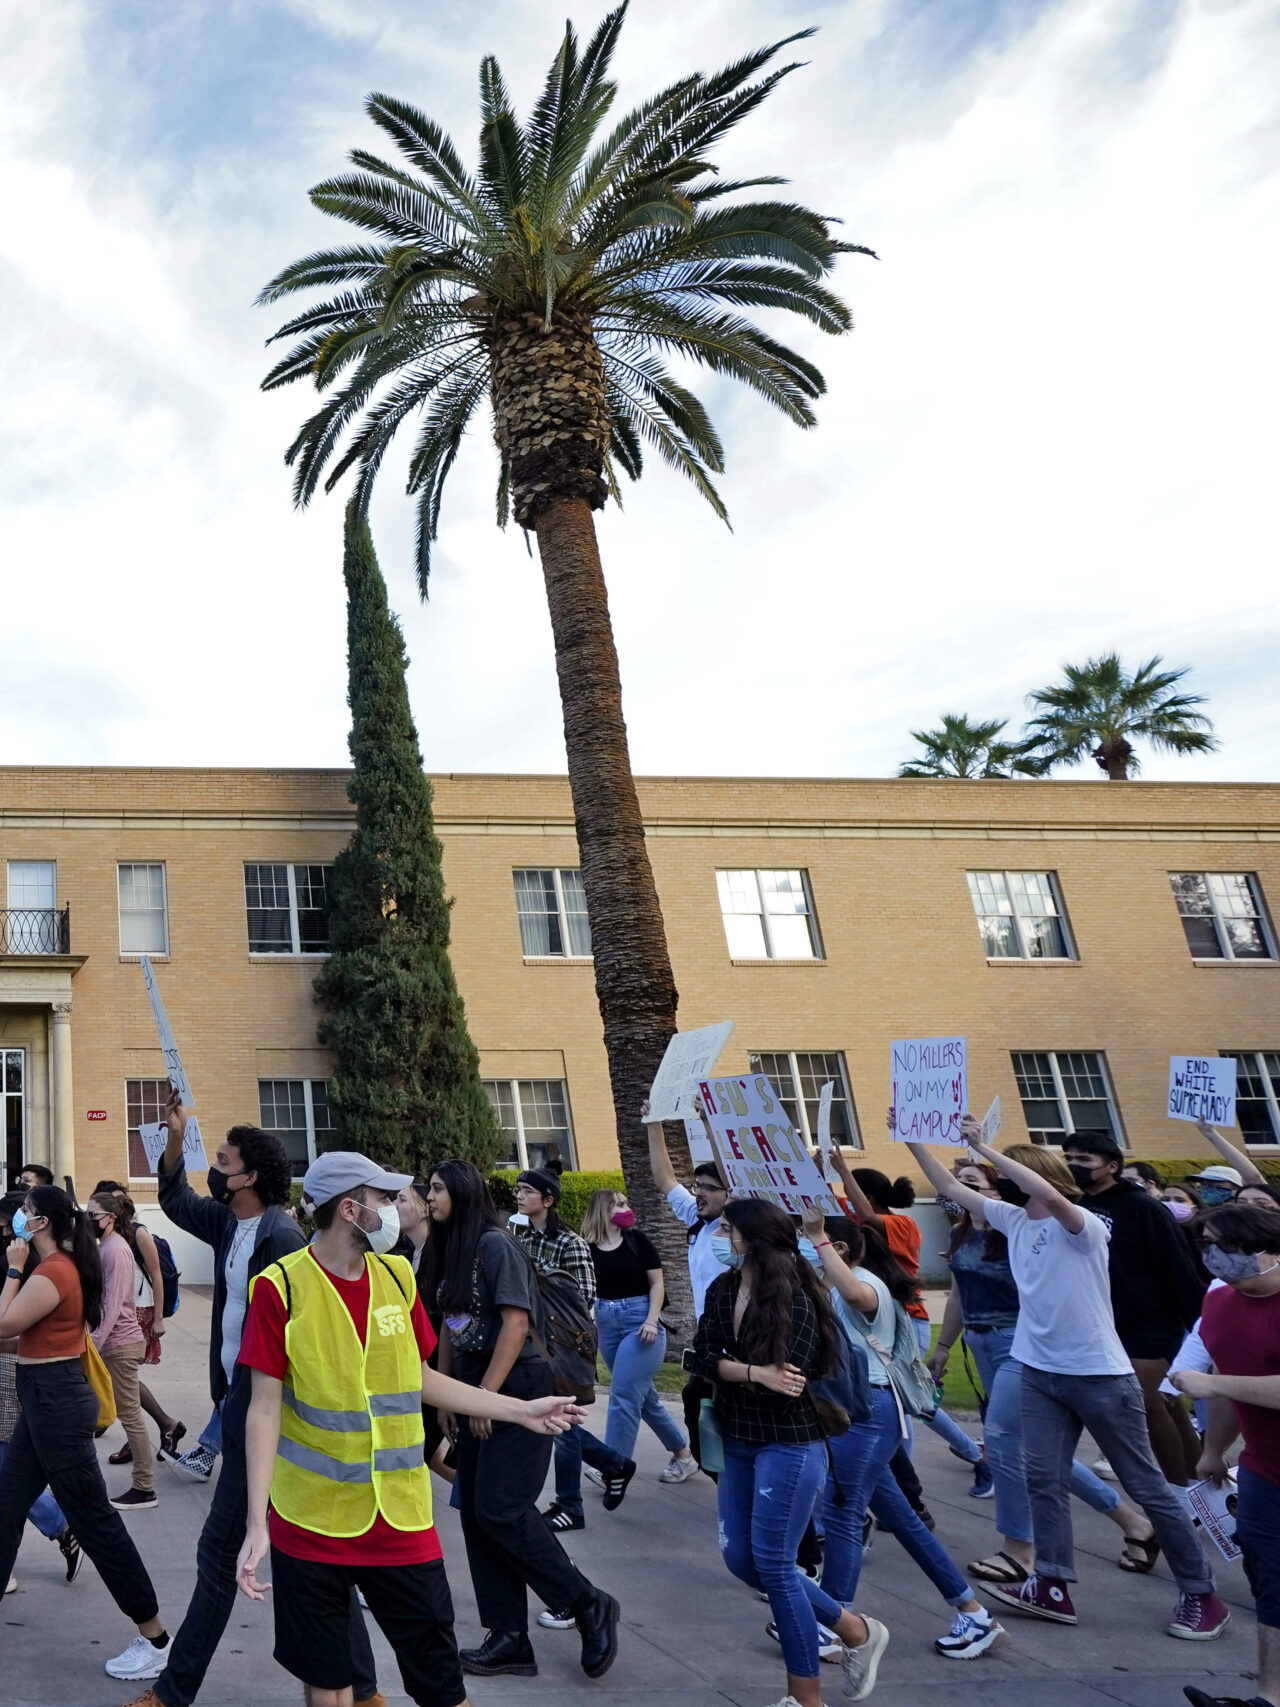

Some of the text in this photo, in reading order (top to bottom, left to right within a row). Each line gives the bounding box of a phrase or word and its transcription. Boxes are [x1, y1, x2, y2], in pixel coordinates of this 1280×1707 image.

[894, 1041, 964, 1074] NO KILLERS
[1186, 1060, 1210, 1074] END
[905, 1079, 949, 1102] ON MY
[1175, 1072, 1217, 1093] WHITE
[1169, 1088, 1232, 1124] SUPREMACY
[899, 1107, 964, 1143] CAMPUS
[715, 1123, 806, 1165] LEGACY
[377, 1313, 406, 1337] SFS
